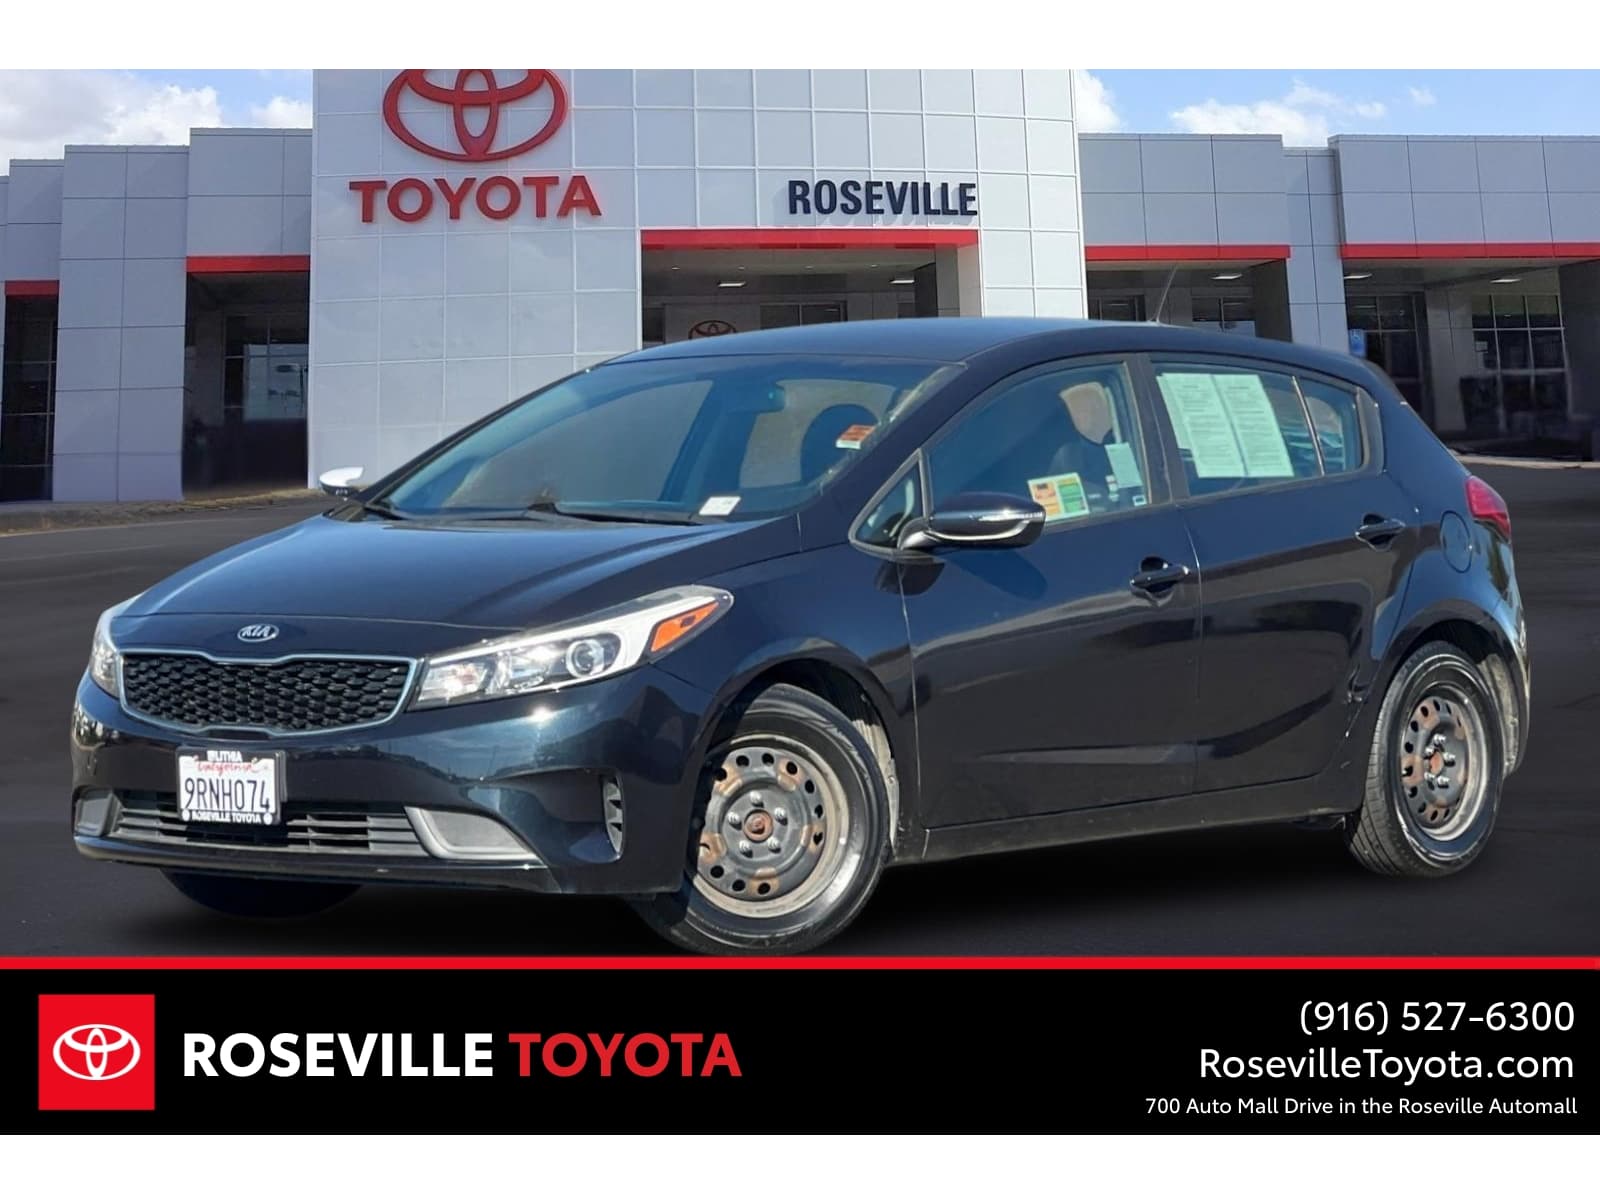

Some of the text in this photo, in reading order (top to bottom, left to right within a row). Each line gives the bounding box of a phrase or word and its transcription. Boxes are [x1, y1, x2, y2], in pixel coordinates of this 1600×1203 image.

[349, 176, 601, 223] TOYOTA
[787, 180, 978, 217] ROSEVILLE
[241, 625, 271, 637] KIA
[184, 778, 270, 812] 9RNH074
[231, 813, 261, 824] TOYOTA
